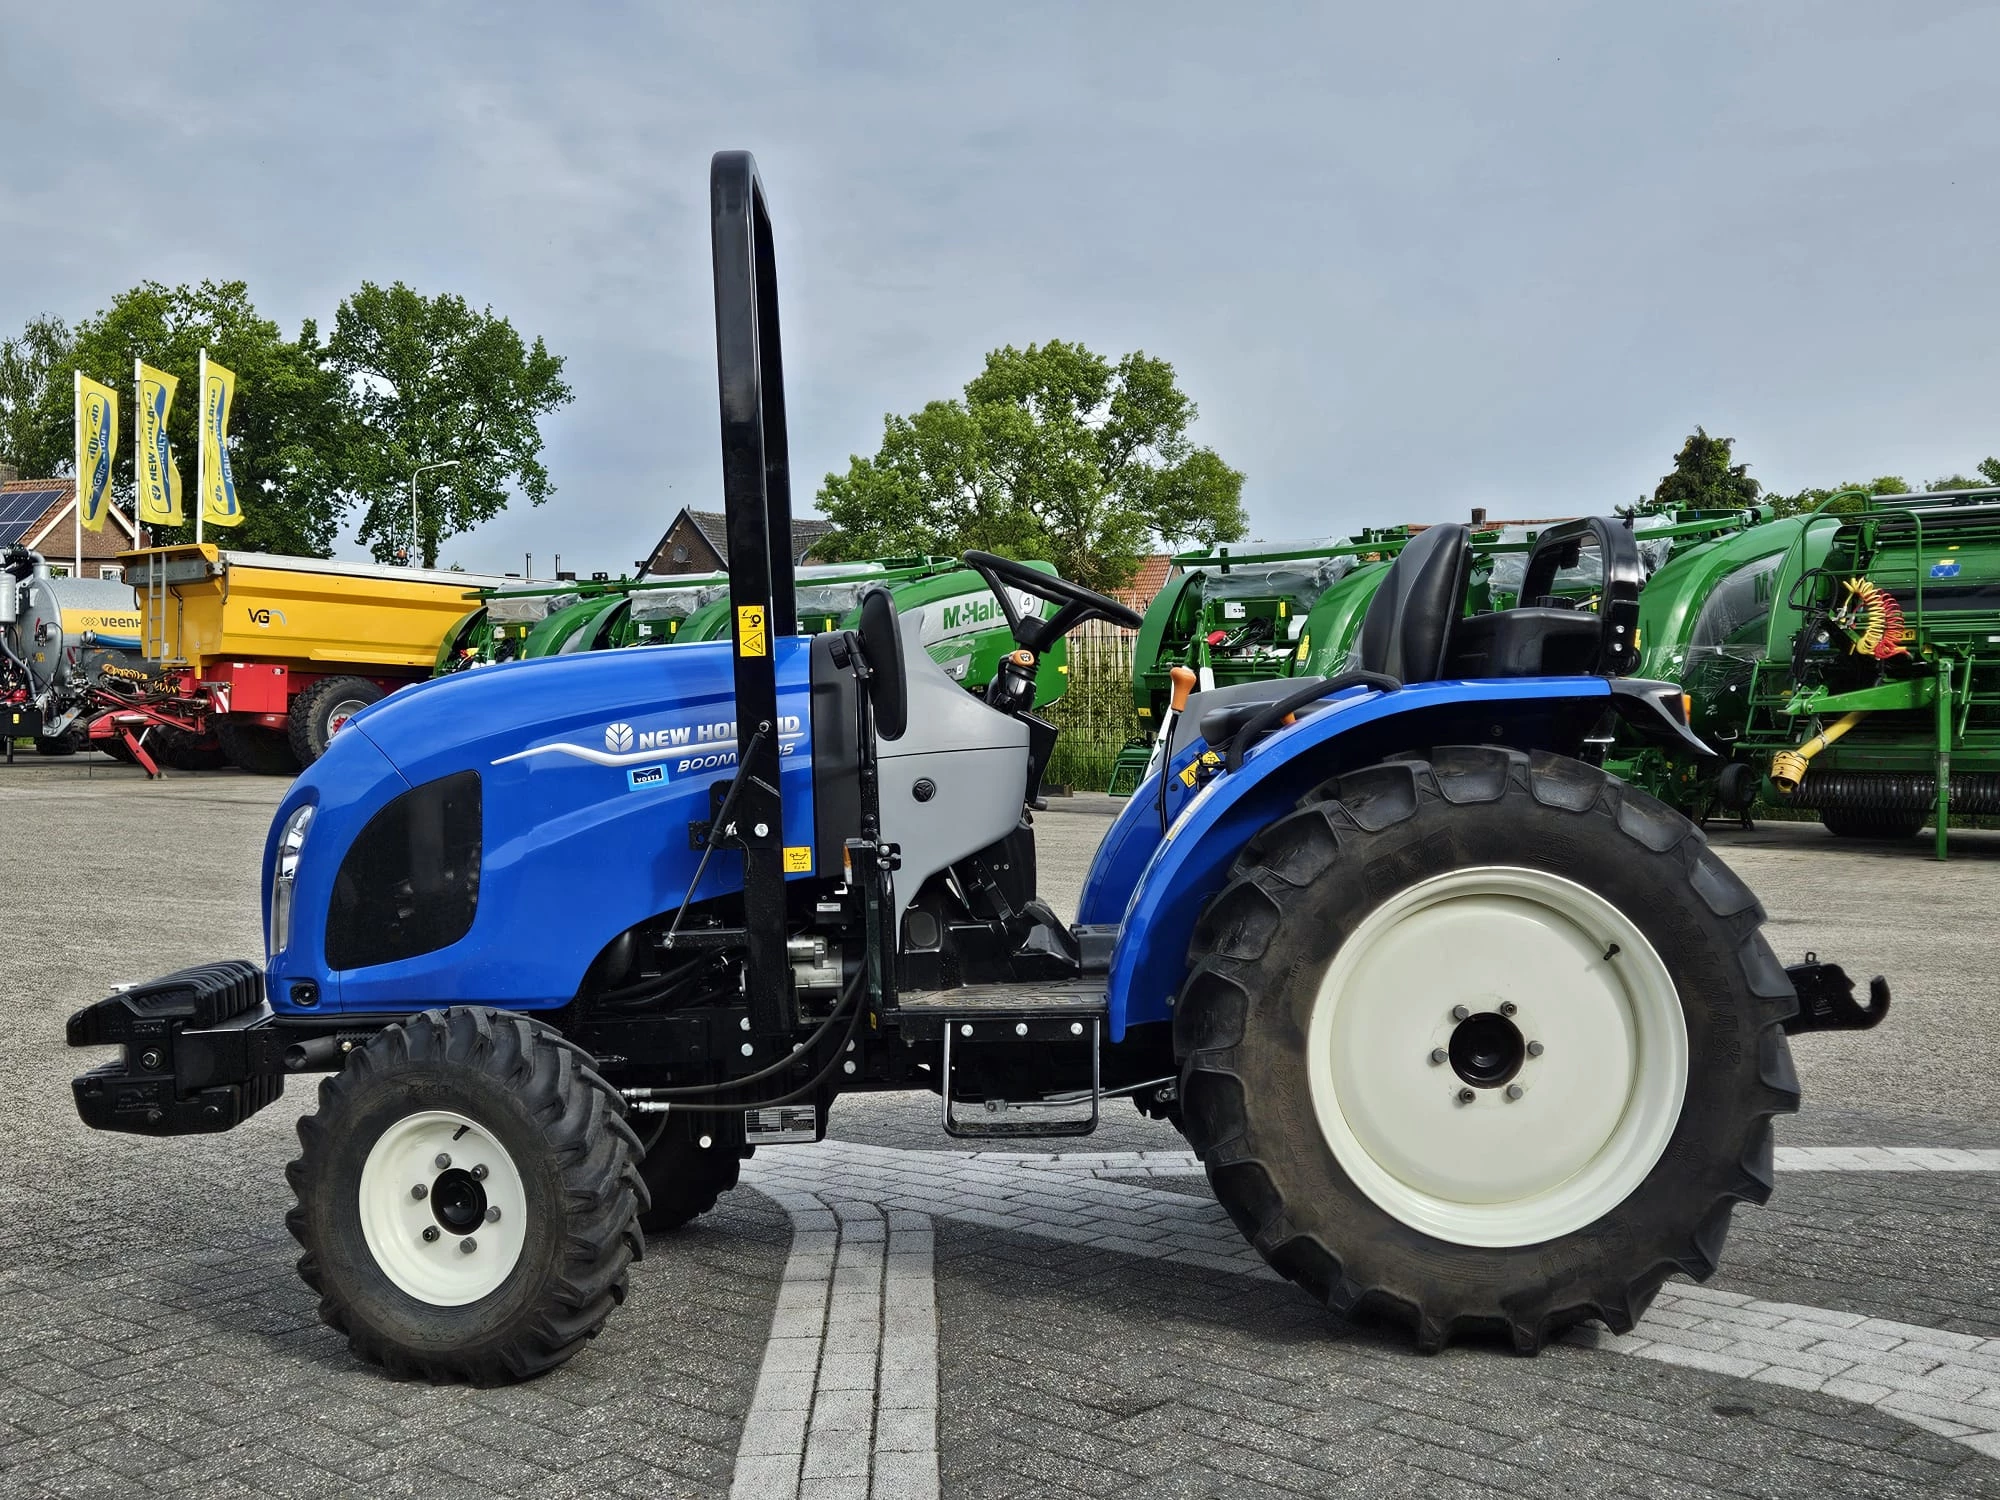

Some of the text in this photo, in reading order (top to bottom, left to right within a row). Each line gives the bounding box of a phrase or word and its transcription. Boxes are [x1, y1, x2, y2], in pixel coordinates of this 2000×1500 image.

[639, 716, 800, 750] NEW HOLD
[677, 752, 737, 773] BOOM
